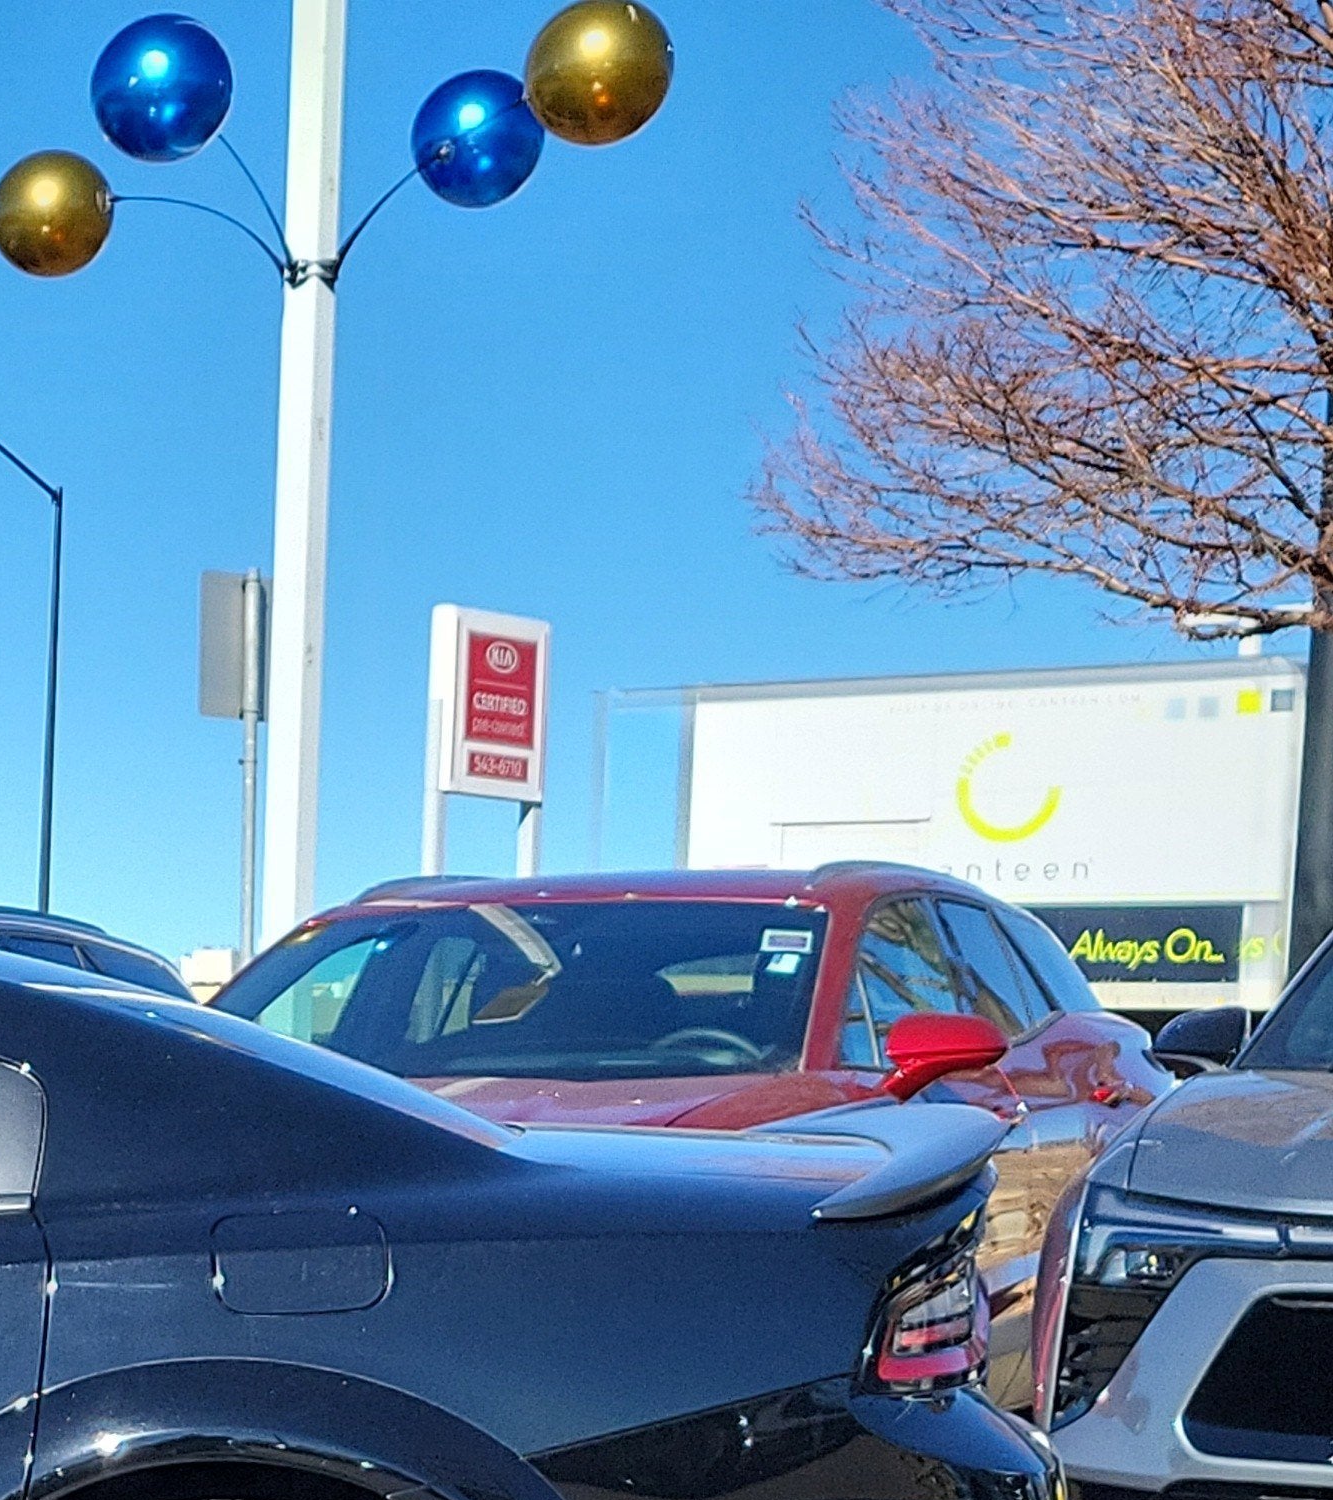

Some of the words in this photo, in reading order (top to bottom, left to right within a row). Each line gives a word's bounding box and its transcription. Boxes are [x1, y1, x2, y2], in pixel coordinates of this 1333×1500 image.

[490, 646, 516, 668] KIA
[473, 692, 529, 716] CERTIFIED
[940, 858, 1089, 882] anteen
[1068, 928, 1161, 971] Always
